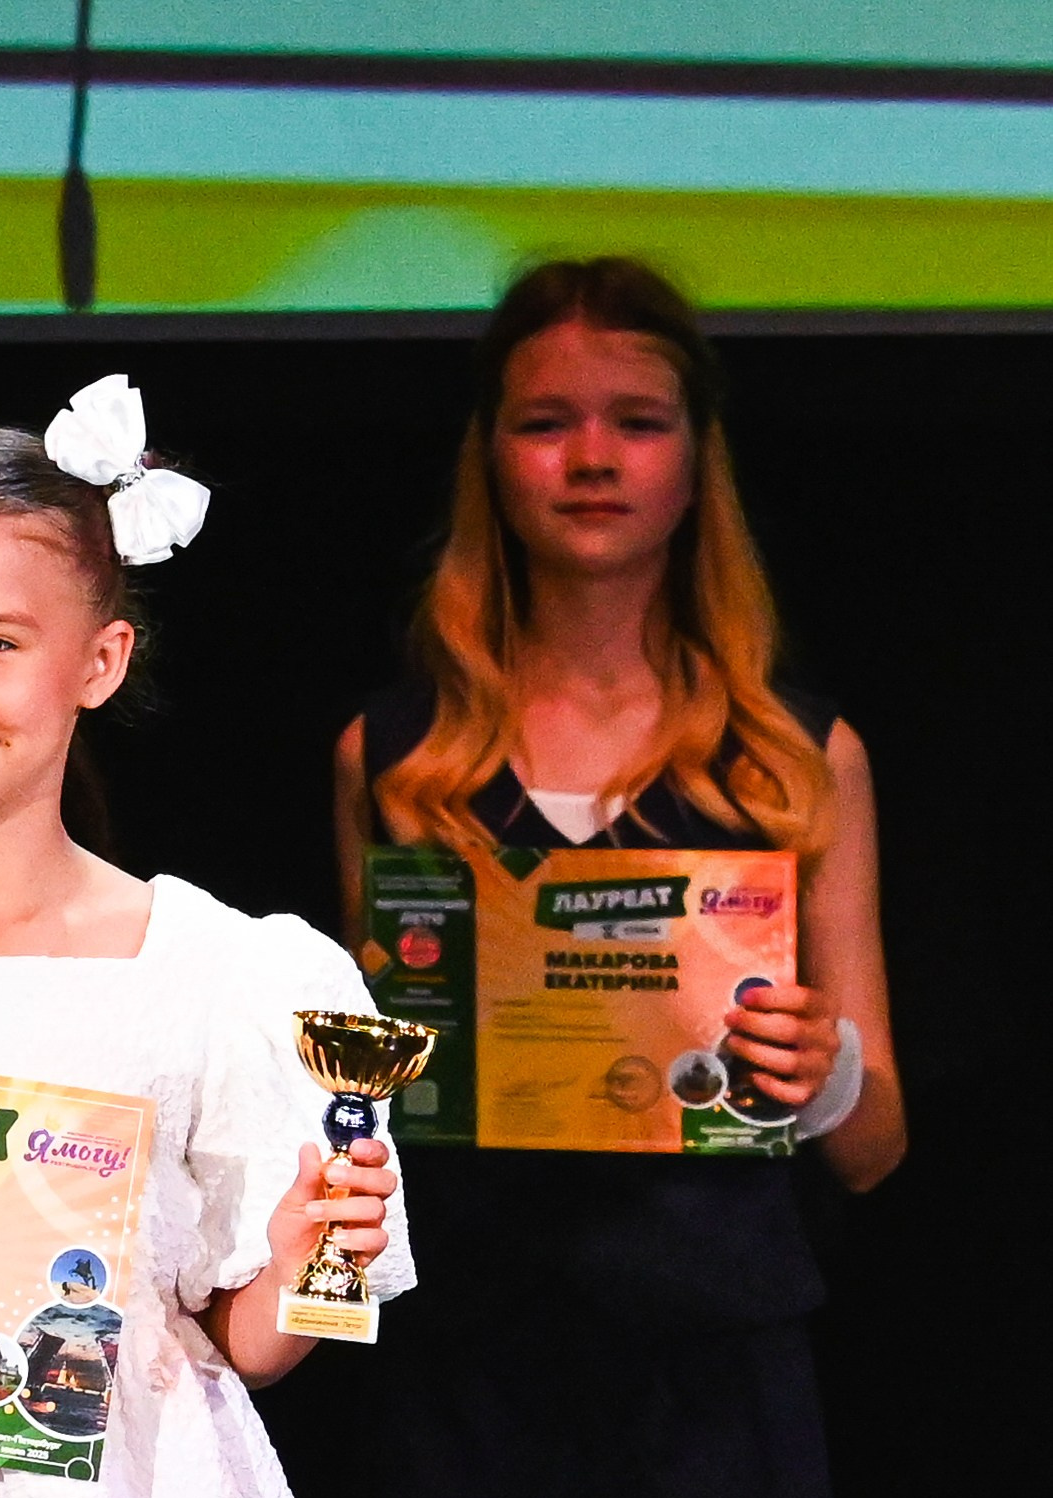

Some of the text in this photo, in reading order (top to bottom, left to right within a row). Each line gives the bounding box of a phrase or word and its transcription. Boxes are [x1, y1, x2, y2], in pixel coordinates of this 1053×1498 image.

[553, 886, 672, 912] ЛАУРЕАТ
[546, 951, 679, 969] МАКАРОВА
[545, 973, 679, 990] ЕКАТЕРИНА
[23, 1128, 55, 1164] Я
[51, 1142, 132, 1178] могу!
